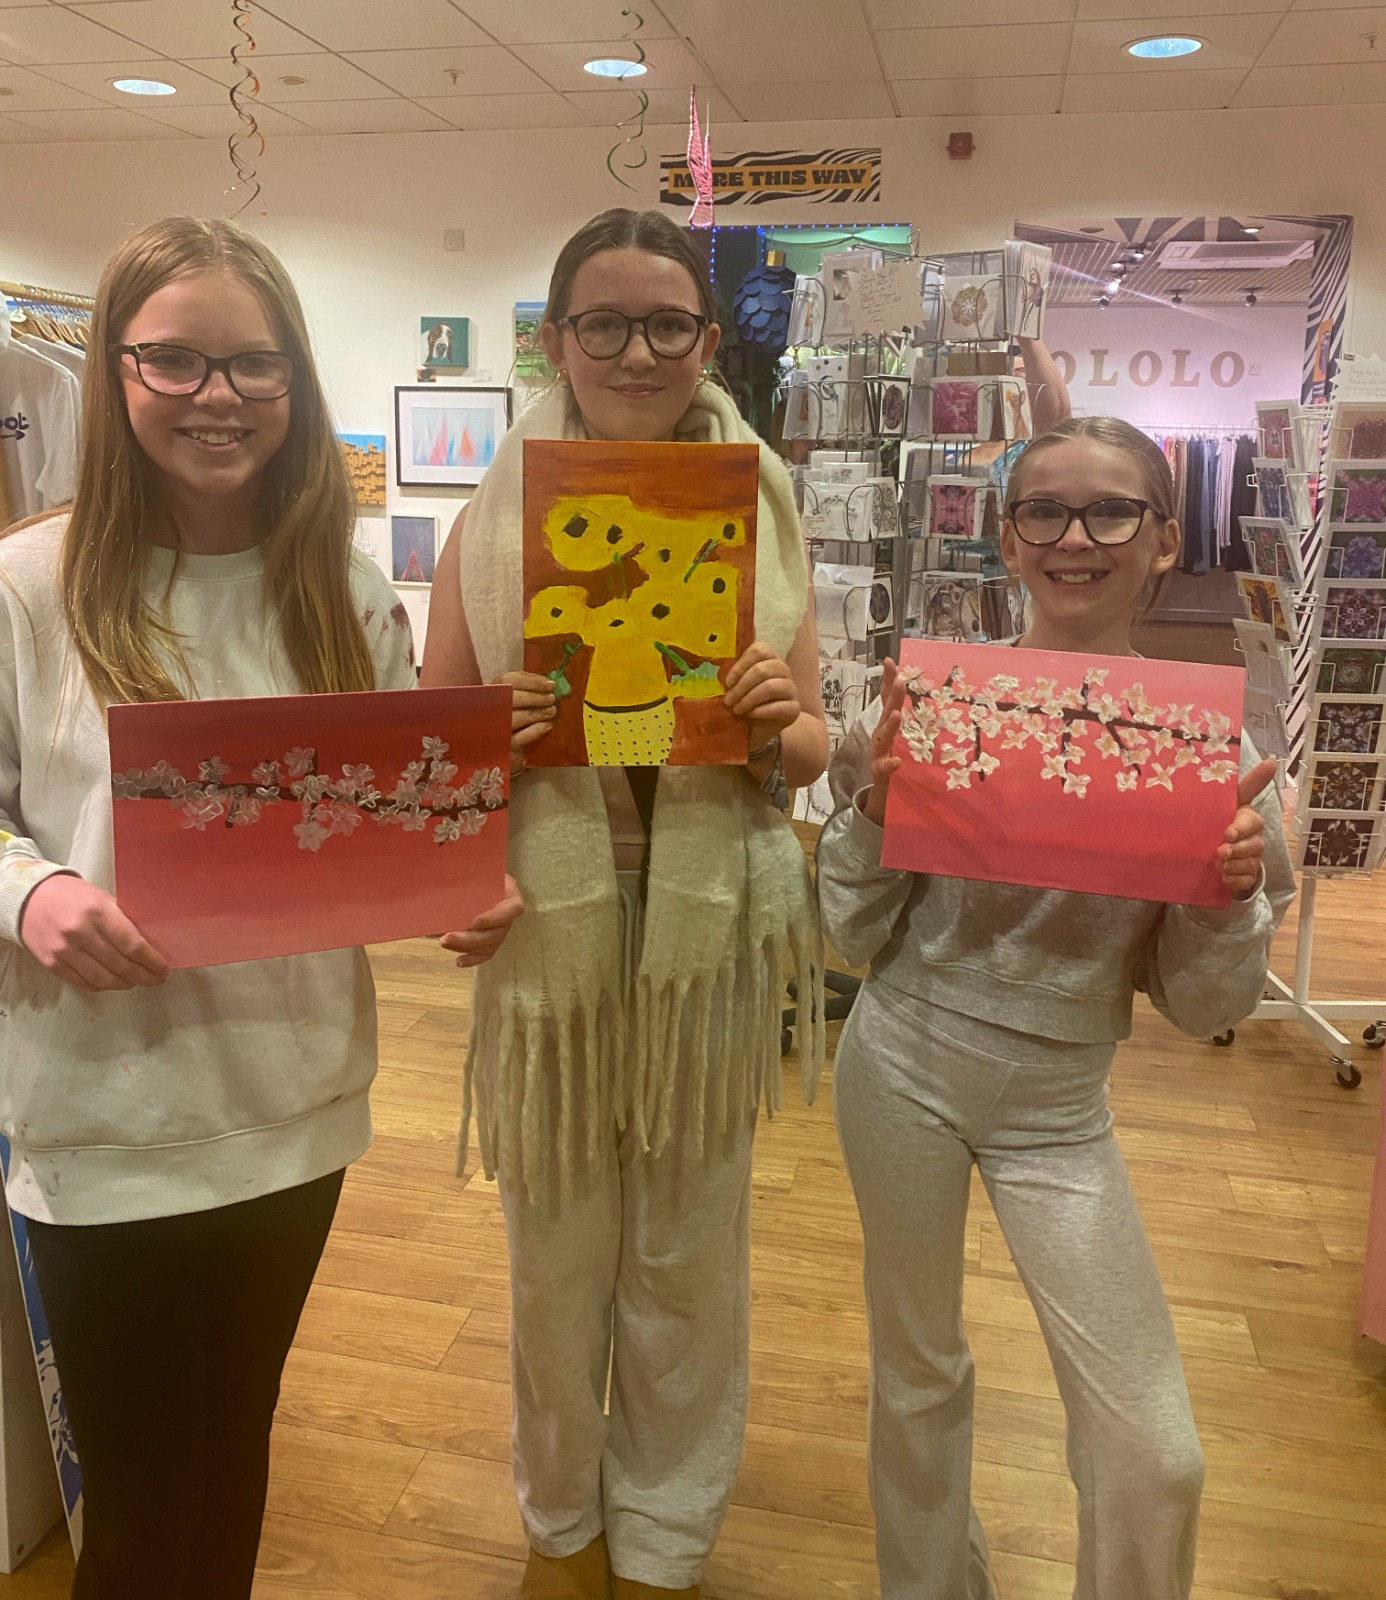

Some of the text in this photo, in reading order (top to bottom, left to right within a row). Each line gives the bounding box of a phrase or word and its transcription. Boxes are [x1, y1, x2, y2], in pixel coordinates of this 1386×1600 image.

[673, 168, 867, 188] MRE THIS WAY
